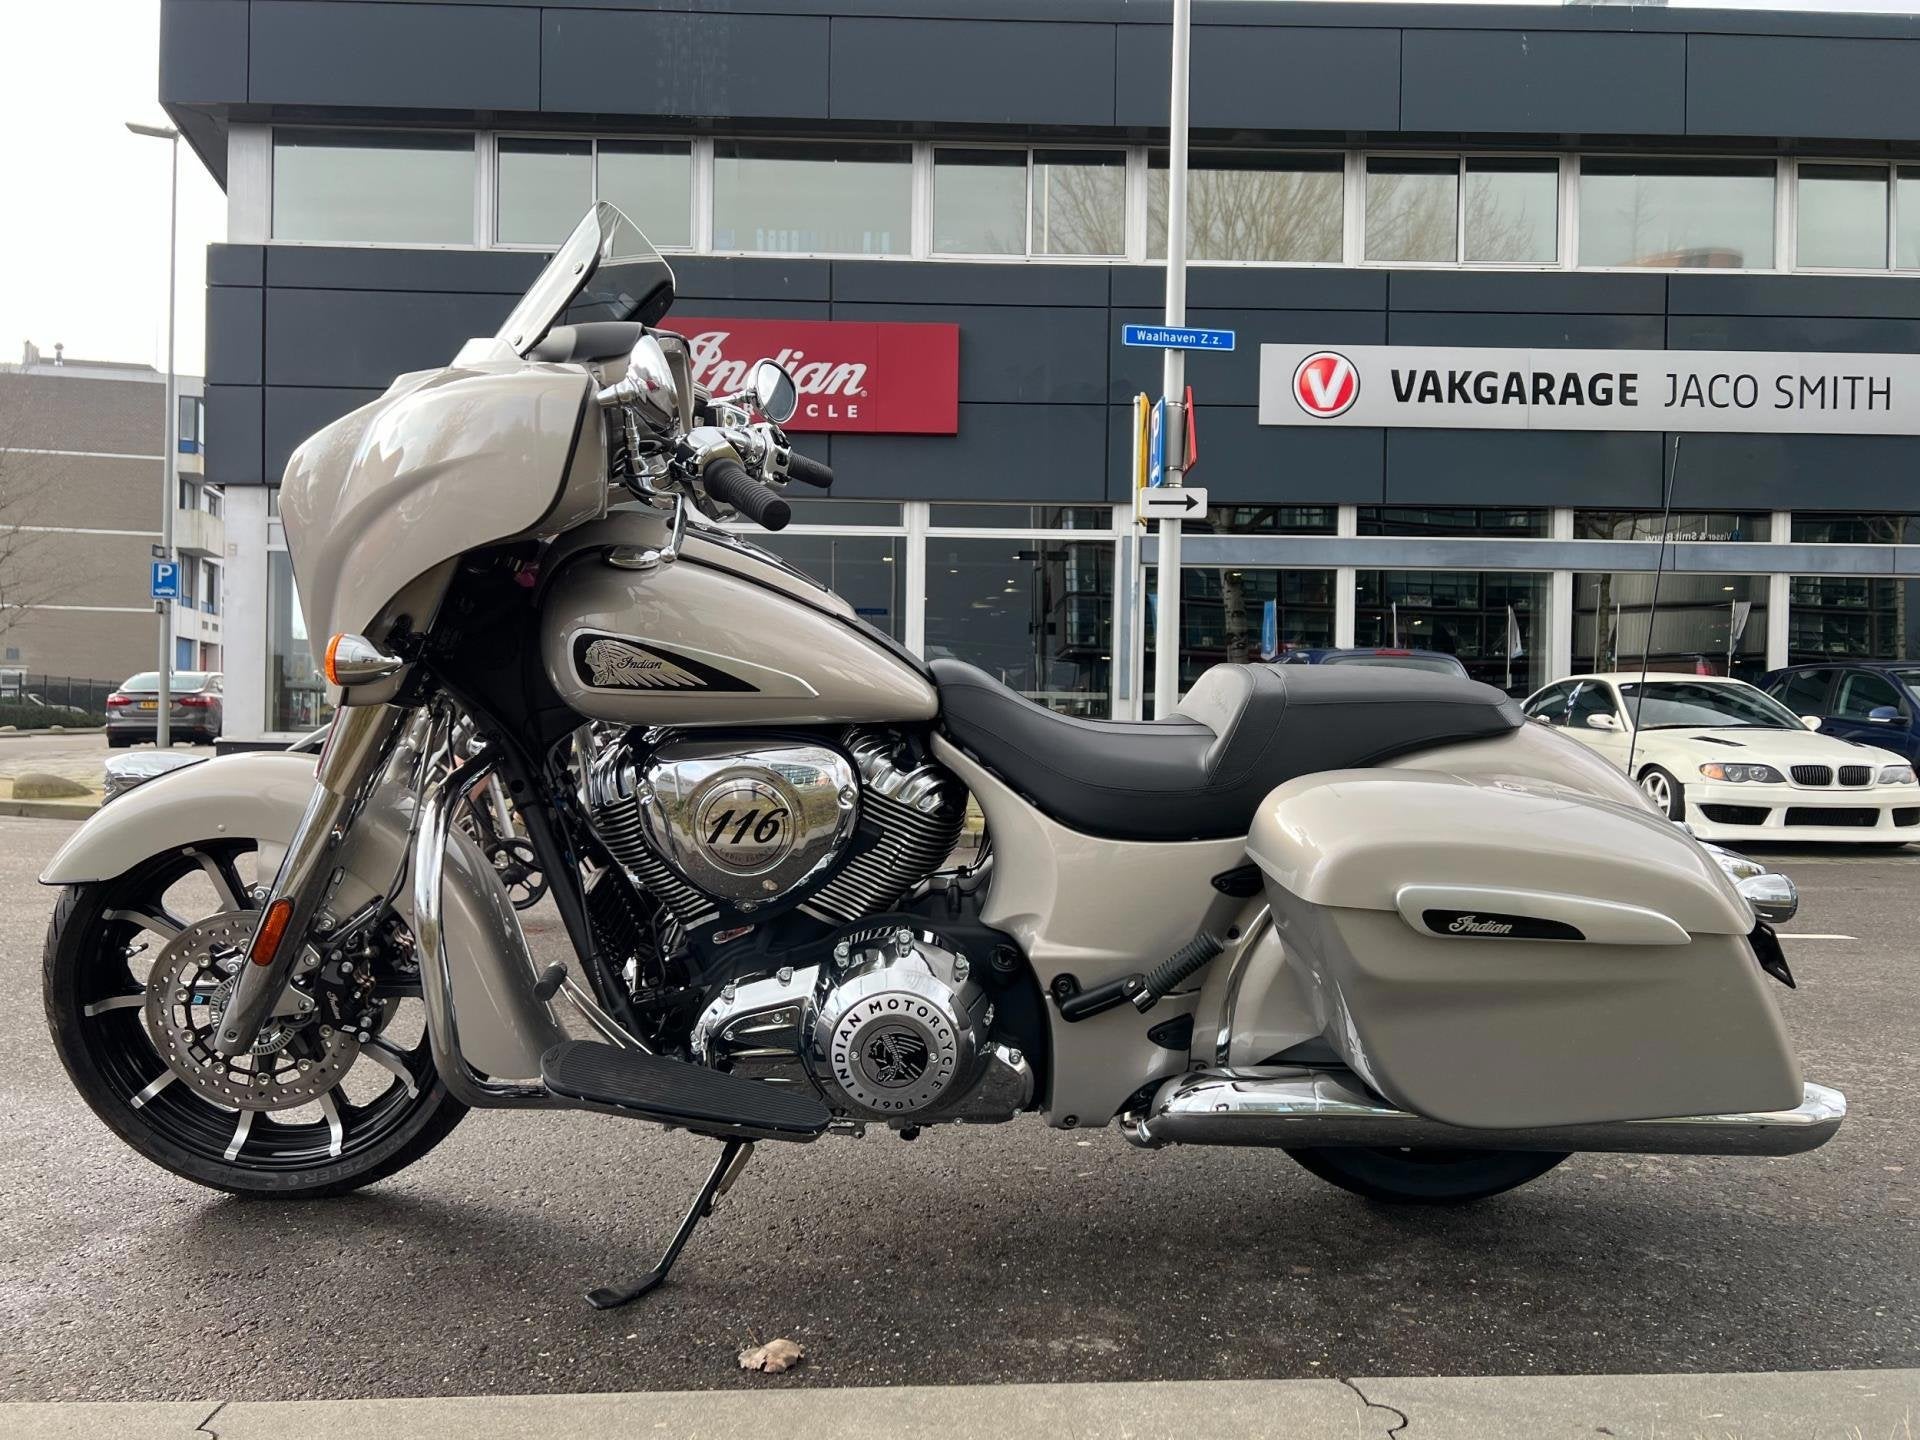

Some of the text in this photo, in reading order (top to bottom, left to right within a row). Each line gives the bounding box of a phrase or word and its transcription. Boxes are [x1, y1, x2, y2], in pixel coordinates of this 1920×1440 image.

[1136, 329, 1196, 344] Waalhaven
[1391, 368, 1892, 411] VAKGARAGE JACO SMITH
[157, 565, 173, 582] P
[616, 656, 663, 670] Indian
[706, 807, 789, 844] 116
[1449, 915, 1513, 934] Indian
[834, 999, 954, 1090] INDIAN MOTORCYCLE
[871, 1098, 916, 1110] 1901
